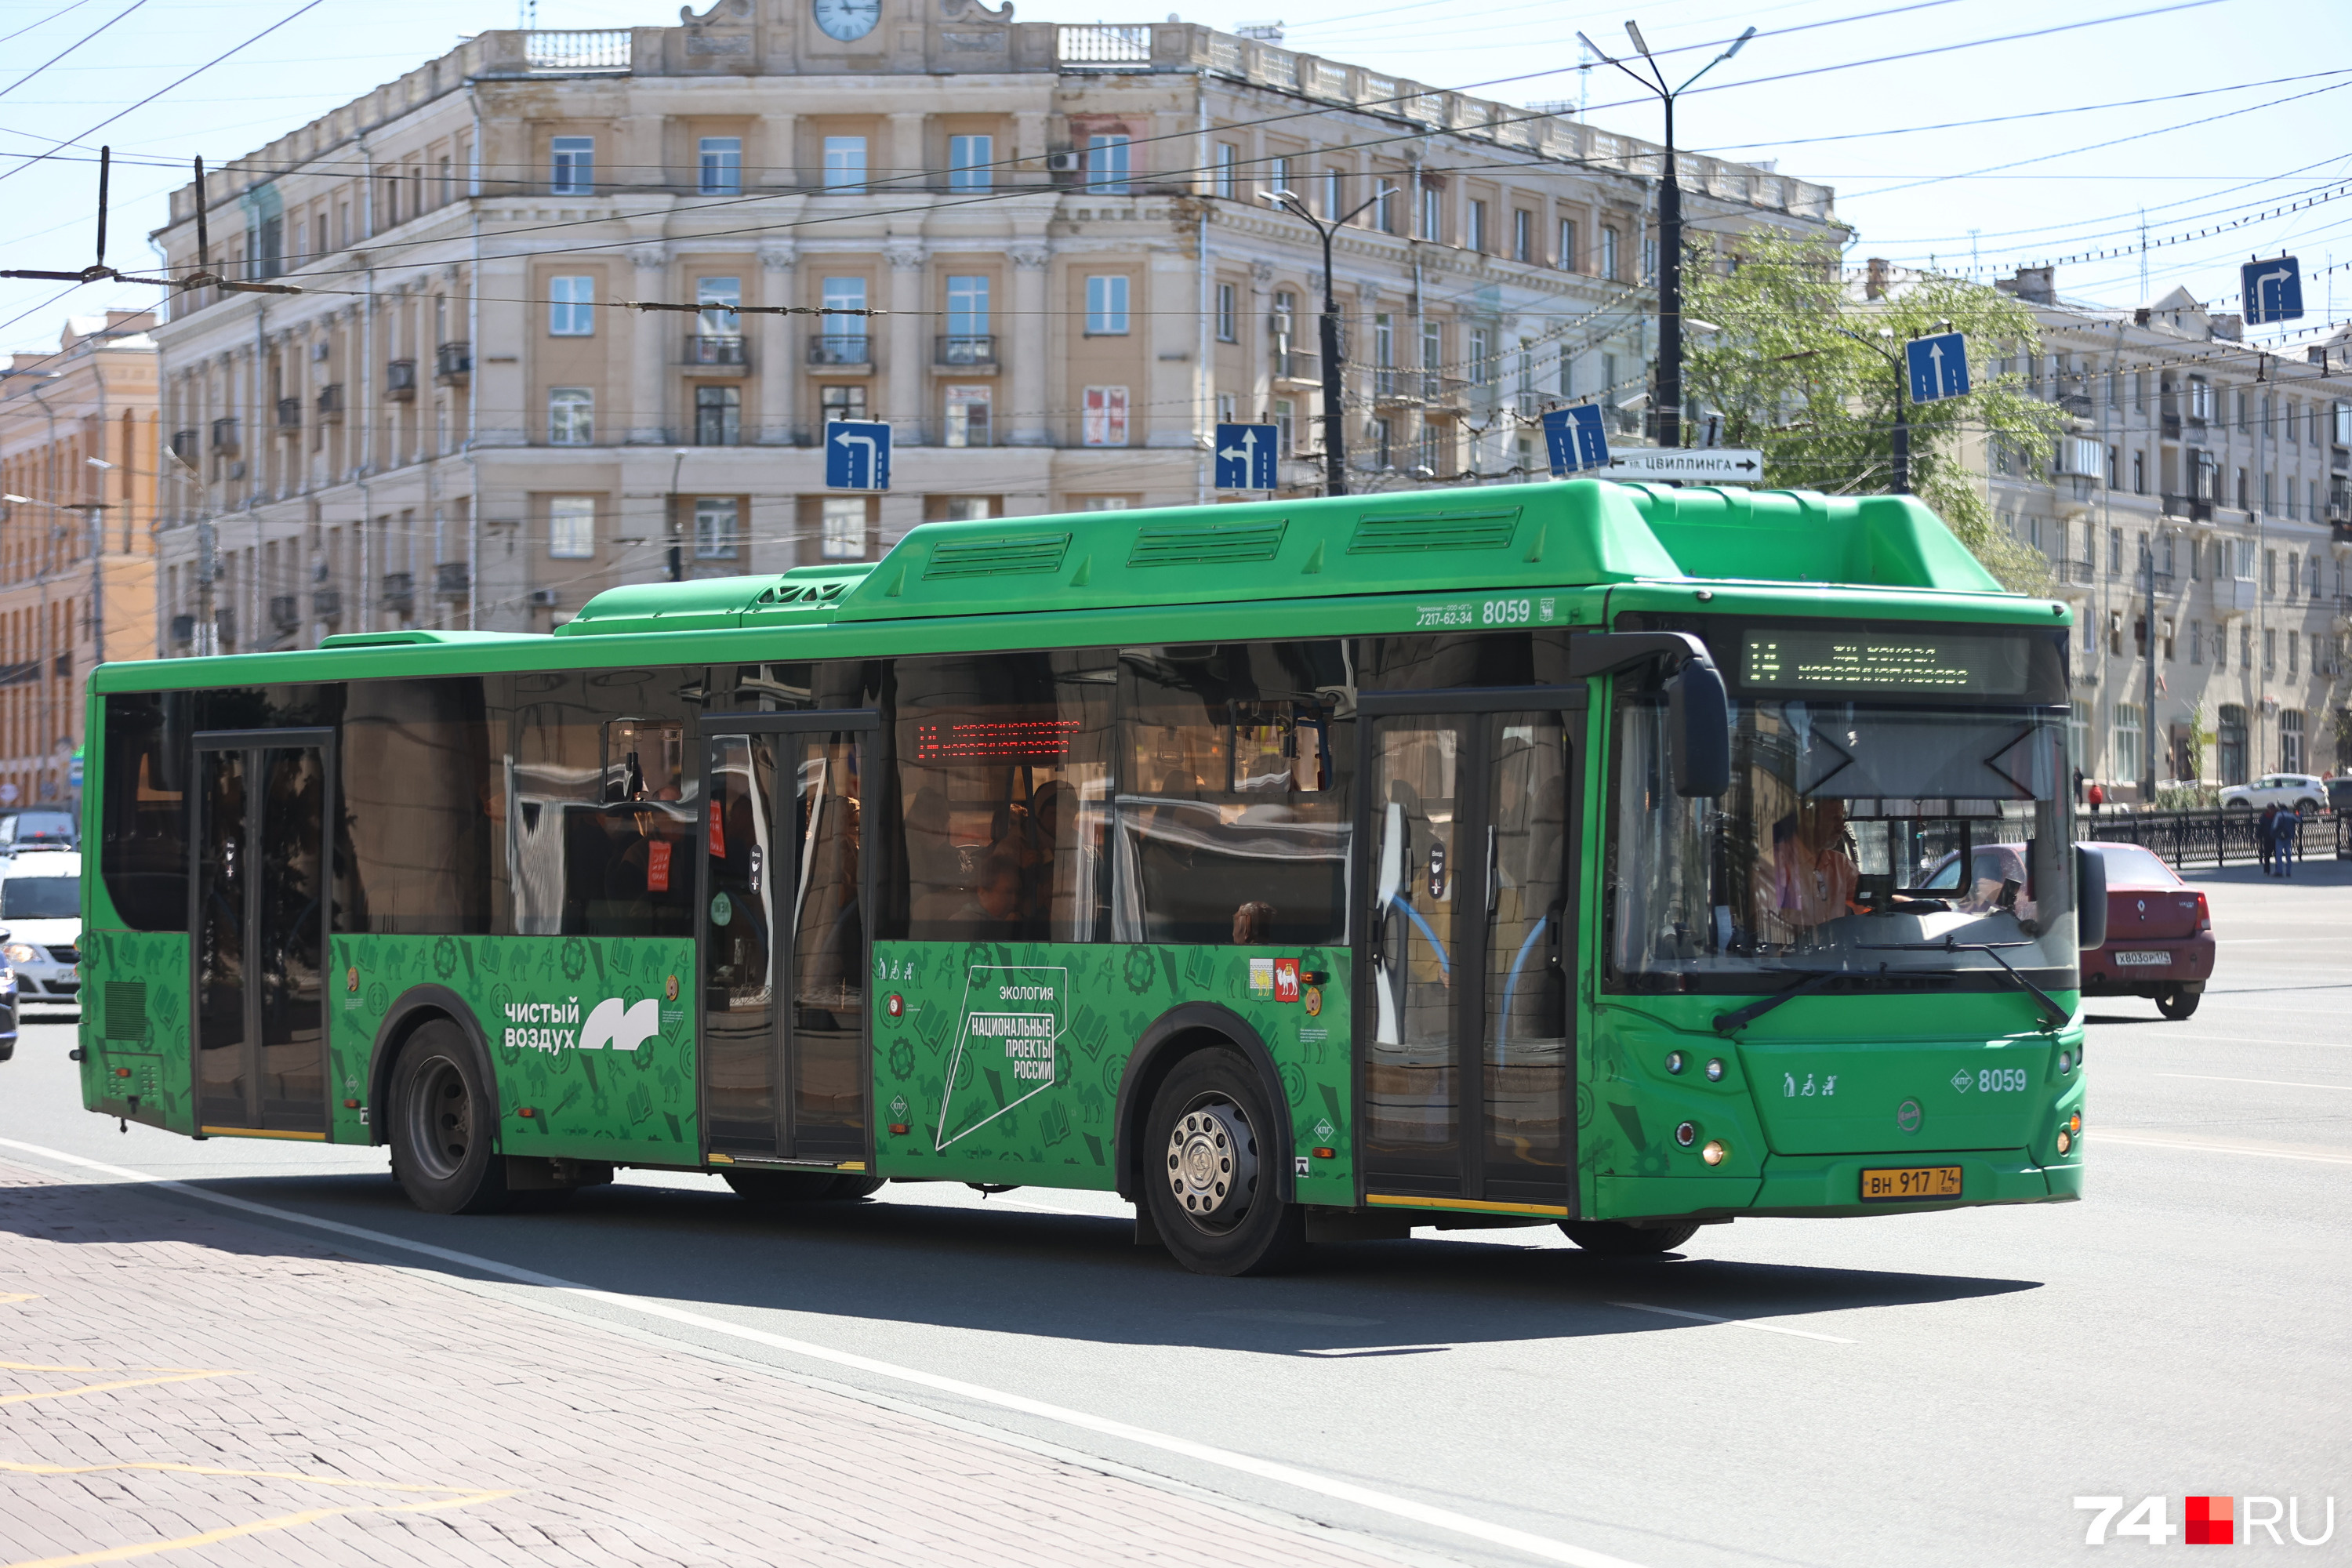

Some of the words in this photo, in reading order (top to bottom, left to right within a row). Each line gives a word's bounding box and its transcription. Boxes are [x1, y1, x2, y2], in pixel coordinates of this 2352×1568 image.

[1646, 457, 1733, 471] ЦВИЛЛИНГА
[1425, 612, 1472, 626] 217-62-34
[1483, 599, 1530, 625] 8059
[1750, 643, 1780, 680] 14
[918, 726, 938, 758] 14
[999, 985, 1054, 1000] ЭКОЛОГИЯ
[971, 1017, 1051, 1038] НАЦИОНАЛЬНЫЕ
[1005, 1039, 1051, 1058] ПРОЕКТЫ
[1014, 1060, 1051, 1080] РОССИИ
[1955, 1076, 1970, 1085] КПГ
[1978, 1069, 2026, 1092] 8059
[1899, 1171, 1931, 1194] 917
[1940, 1169, 1955, 1186] 74
